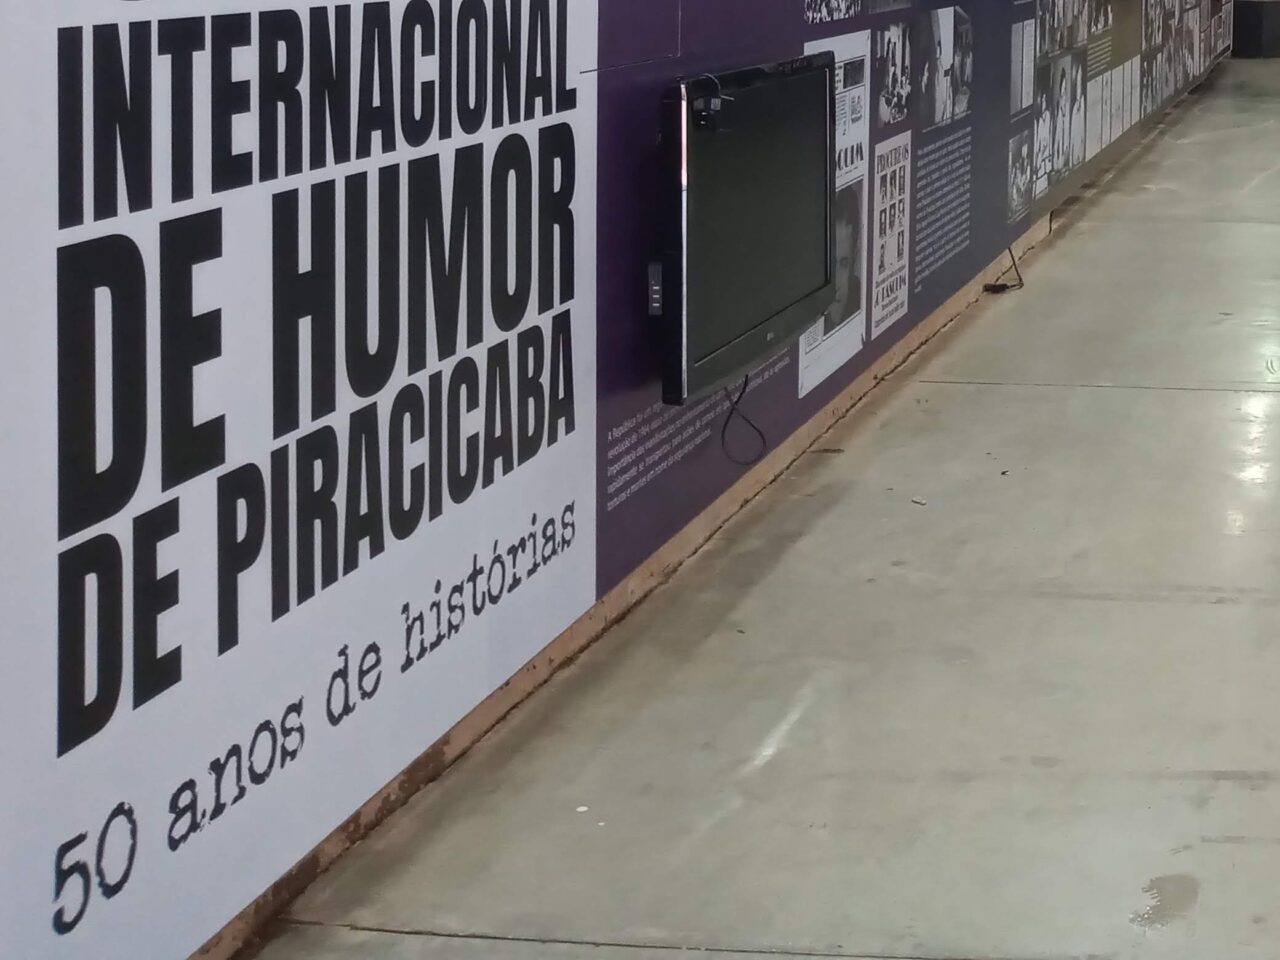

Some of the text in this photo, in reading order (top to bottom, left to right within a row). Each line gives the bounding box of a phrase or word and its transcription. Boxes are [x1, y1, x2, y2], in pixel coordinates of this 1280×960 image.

[56, 206, 226, 542] DE
[271, 121, 576, 440] HUMOR
[57, 308, 576, 758] DE PIRACICABA
[52, 500, 576, 935] 50 anos de histórias
